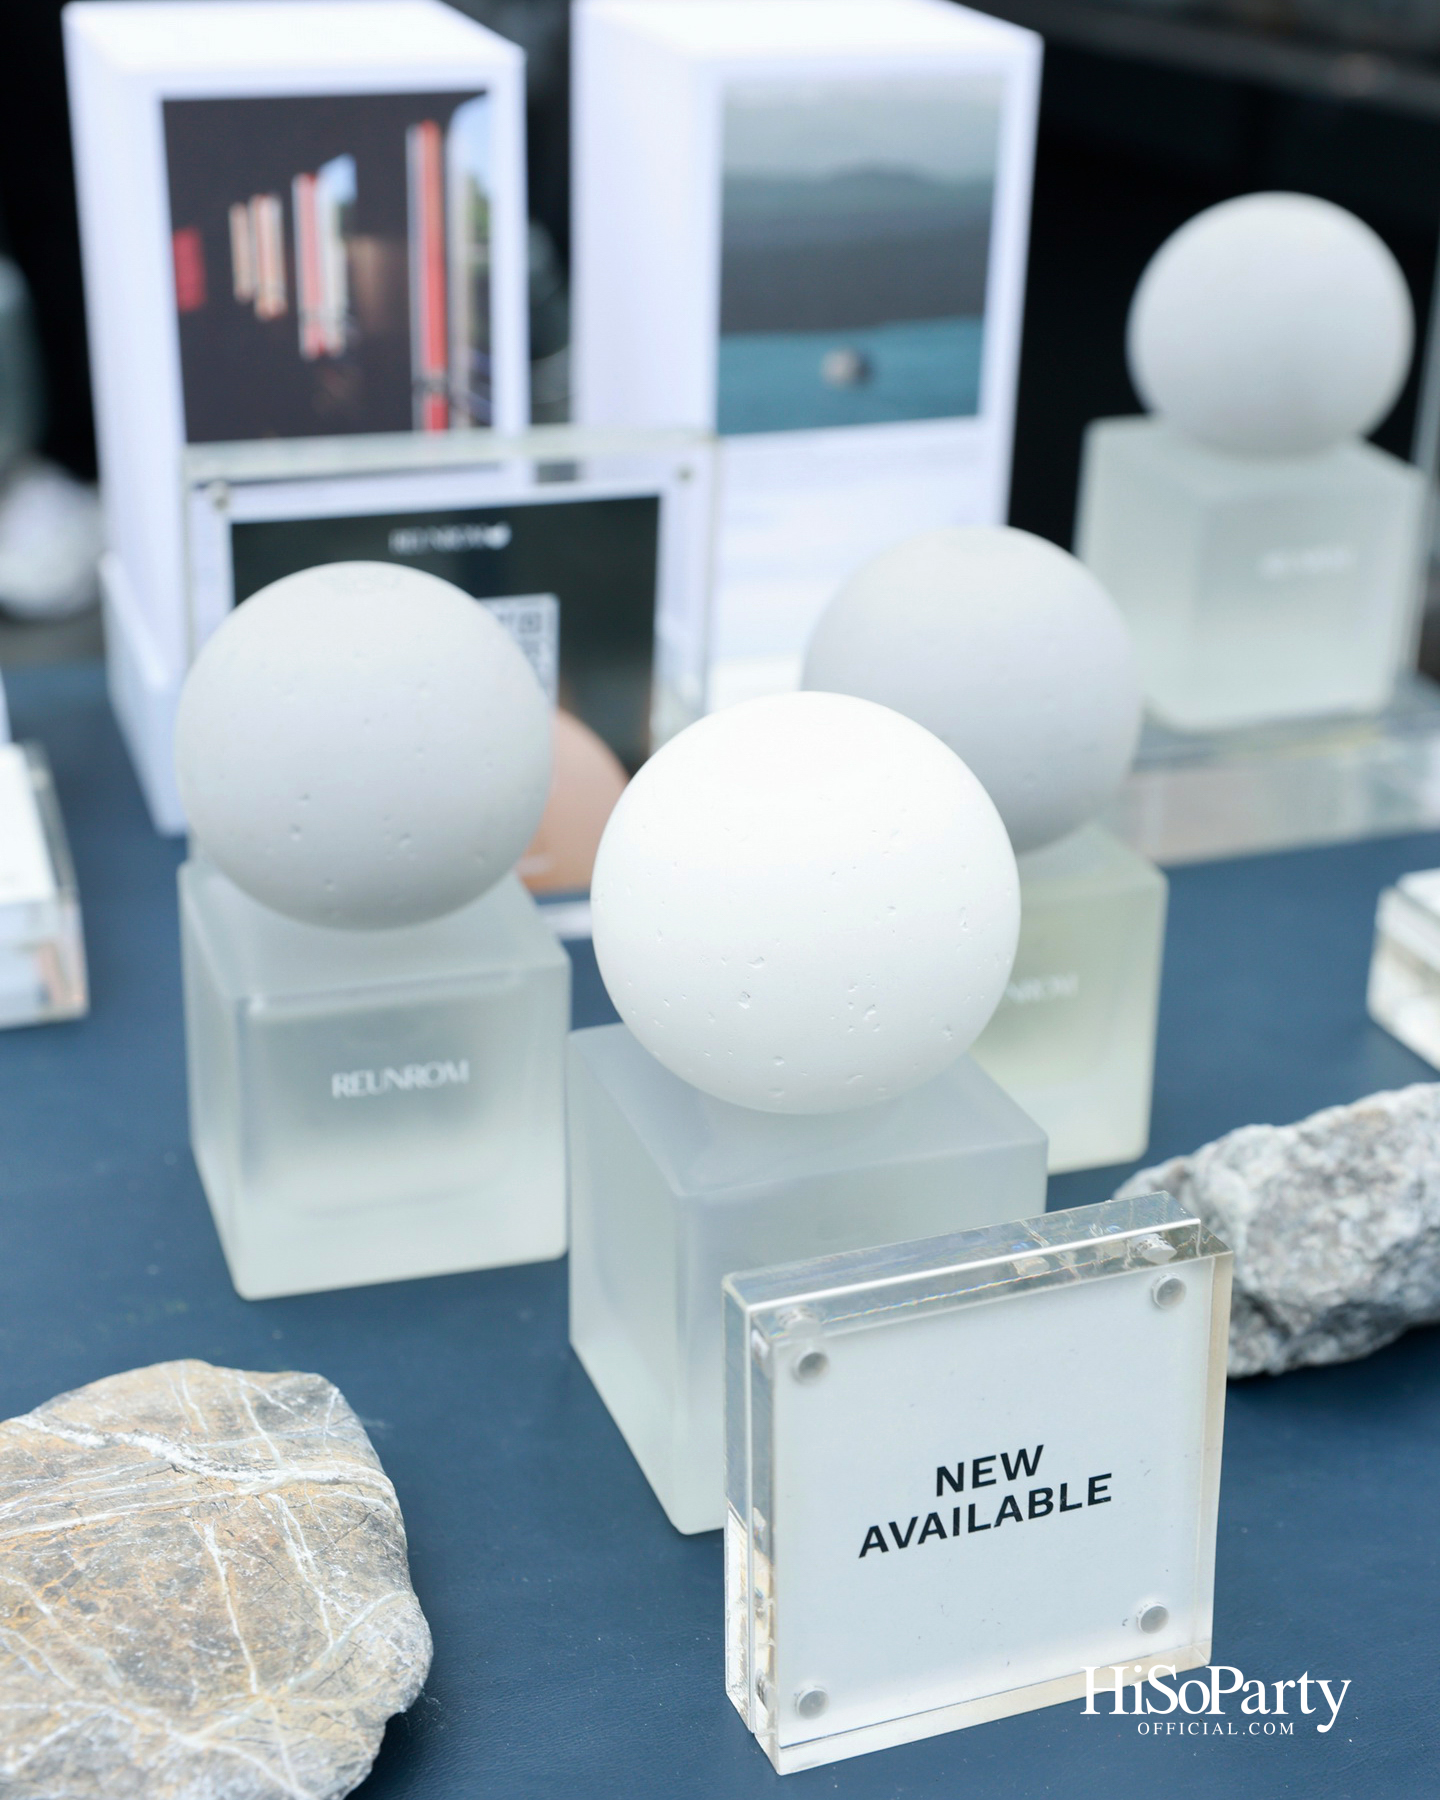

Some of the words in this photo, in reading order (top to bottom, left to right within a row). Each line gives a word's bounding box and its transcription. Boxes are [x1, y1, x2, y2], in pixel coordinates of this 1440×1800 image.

[332, 1059, 470, 1098] REUNROM
[936, 1444, 1044, 1497] NEW
[858, 1473, 1112, 1558] AVAILABLE
